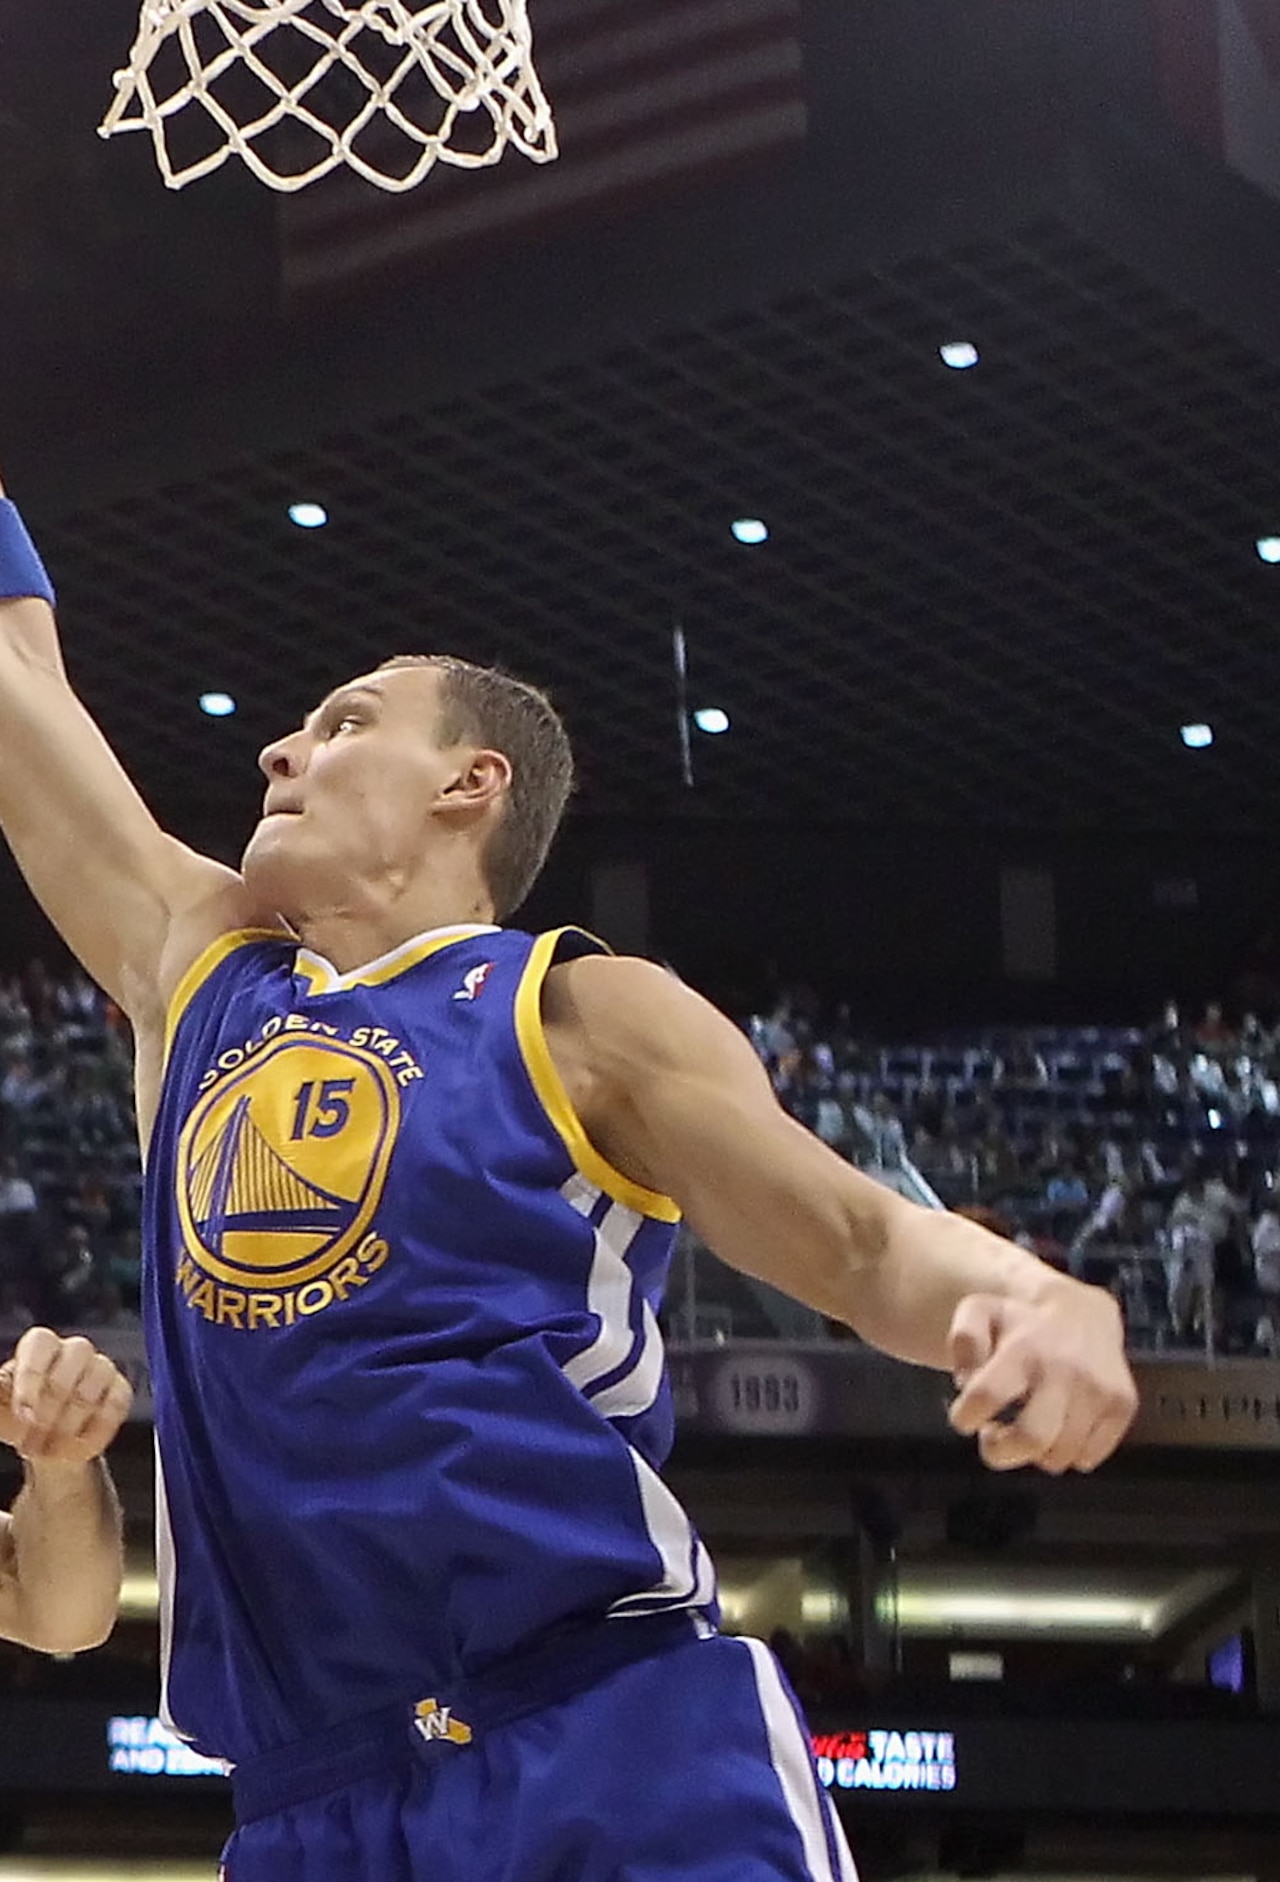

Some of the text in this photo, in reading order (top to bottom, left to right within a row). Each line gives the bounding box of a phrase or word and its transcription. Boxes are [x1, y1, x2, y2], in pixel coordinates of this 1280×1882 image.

[348, 1026, 425, 1088] STATE
[289, 1077, 357, 1142] 15
[175, 1231, 391, 1330] WARRIORS
